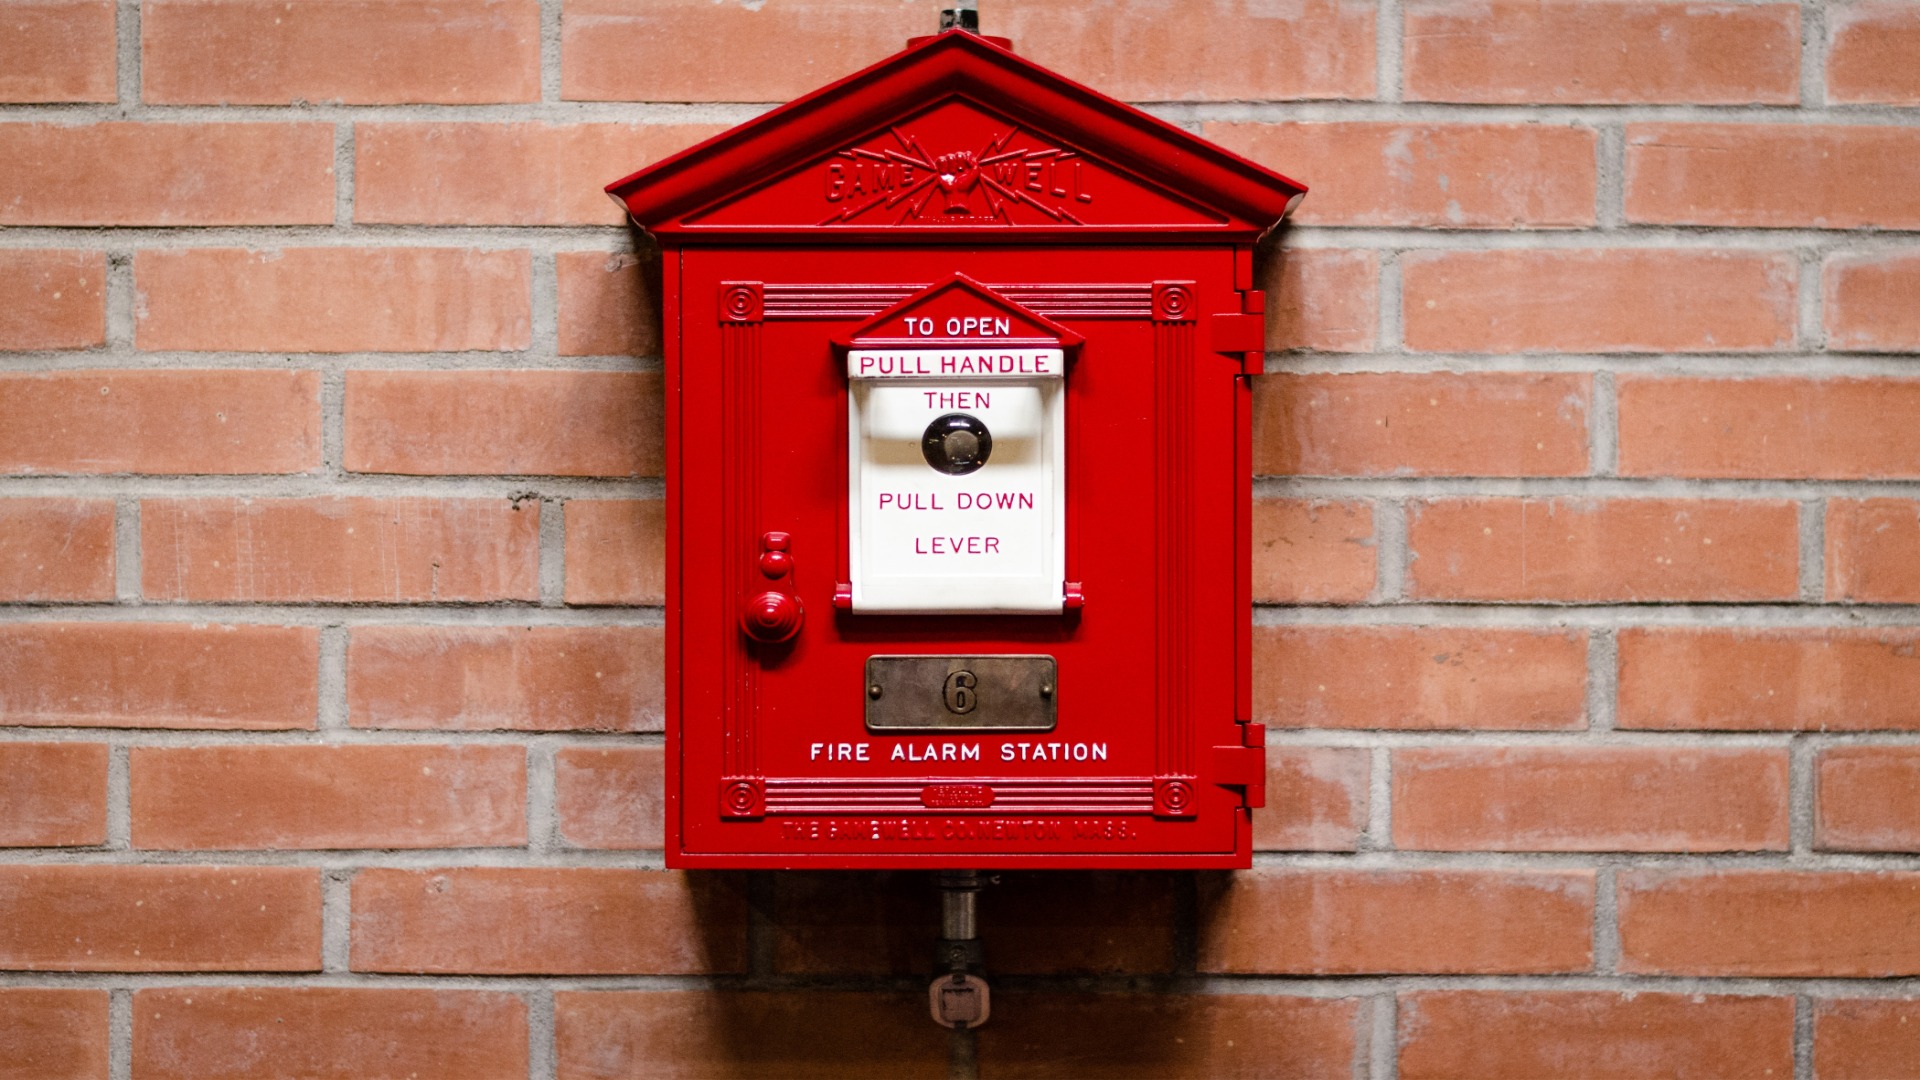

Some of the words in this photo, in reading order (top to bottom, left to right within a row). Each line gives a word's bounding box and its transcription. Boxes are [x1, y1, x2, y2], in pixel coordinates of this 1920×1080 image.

[825, 163, 915, 202] GAME
[995, 162, 1092, 203] WELL
[904, 317, 934, 336] TO
[946, 317, 1010, 336] OPEN
[860, 356, 931, 374] PULL
[941, 355, 1050, 374] HANDLE
[924, 392, 990, 409] THEN
[879, 493, 944, 510] PULL
[957, 492, 1033, 510] DOWN
[915, 536, 999, 554] LEVER
[942, 669, 978, 715] 6
[810, 743, 870, 761] FIRE
[891, 743, 980, 761] ALARM
[1000, 743, 1107, 761] STATION
